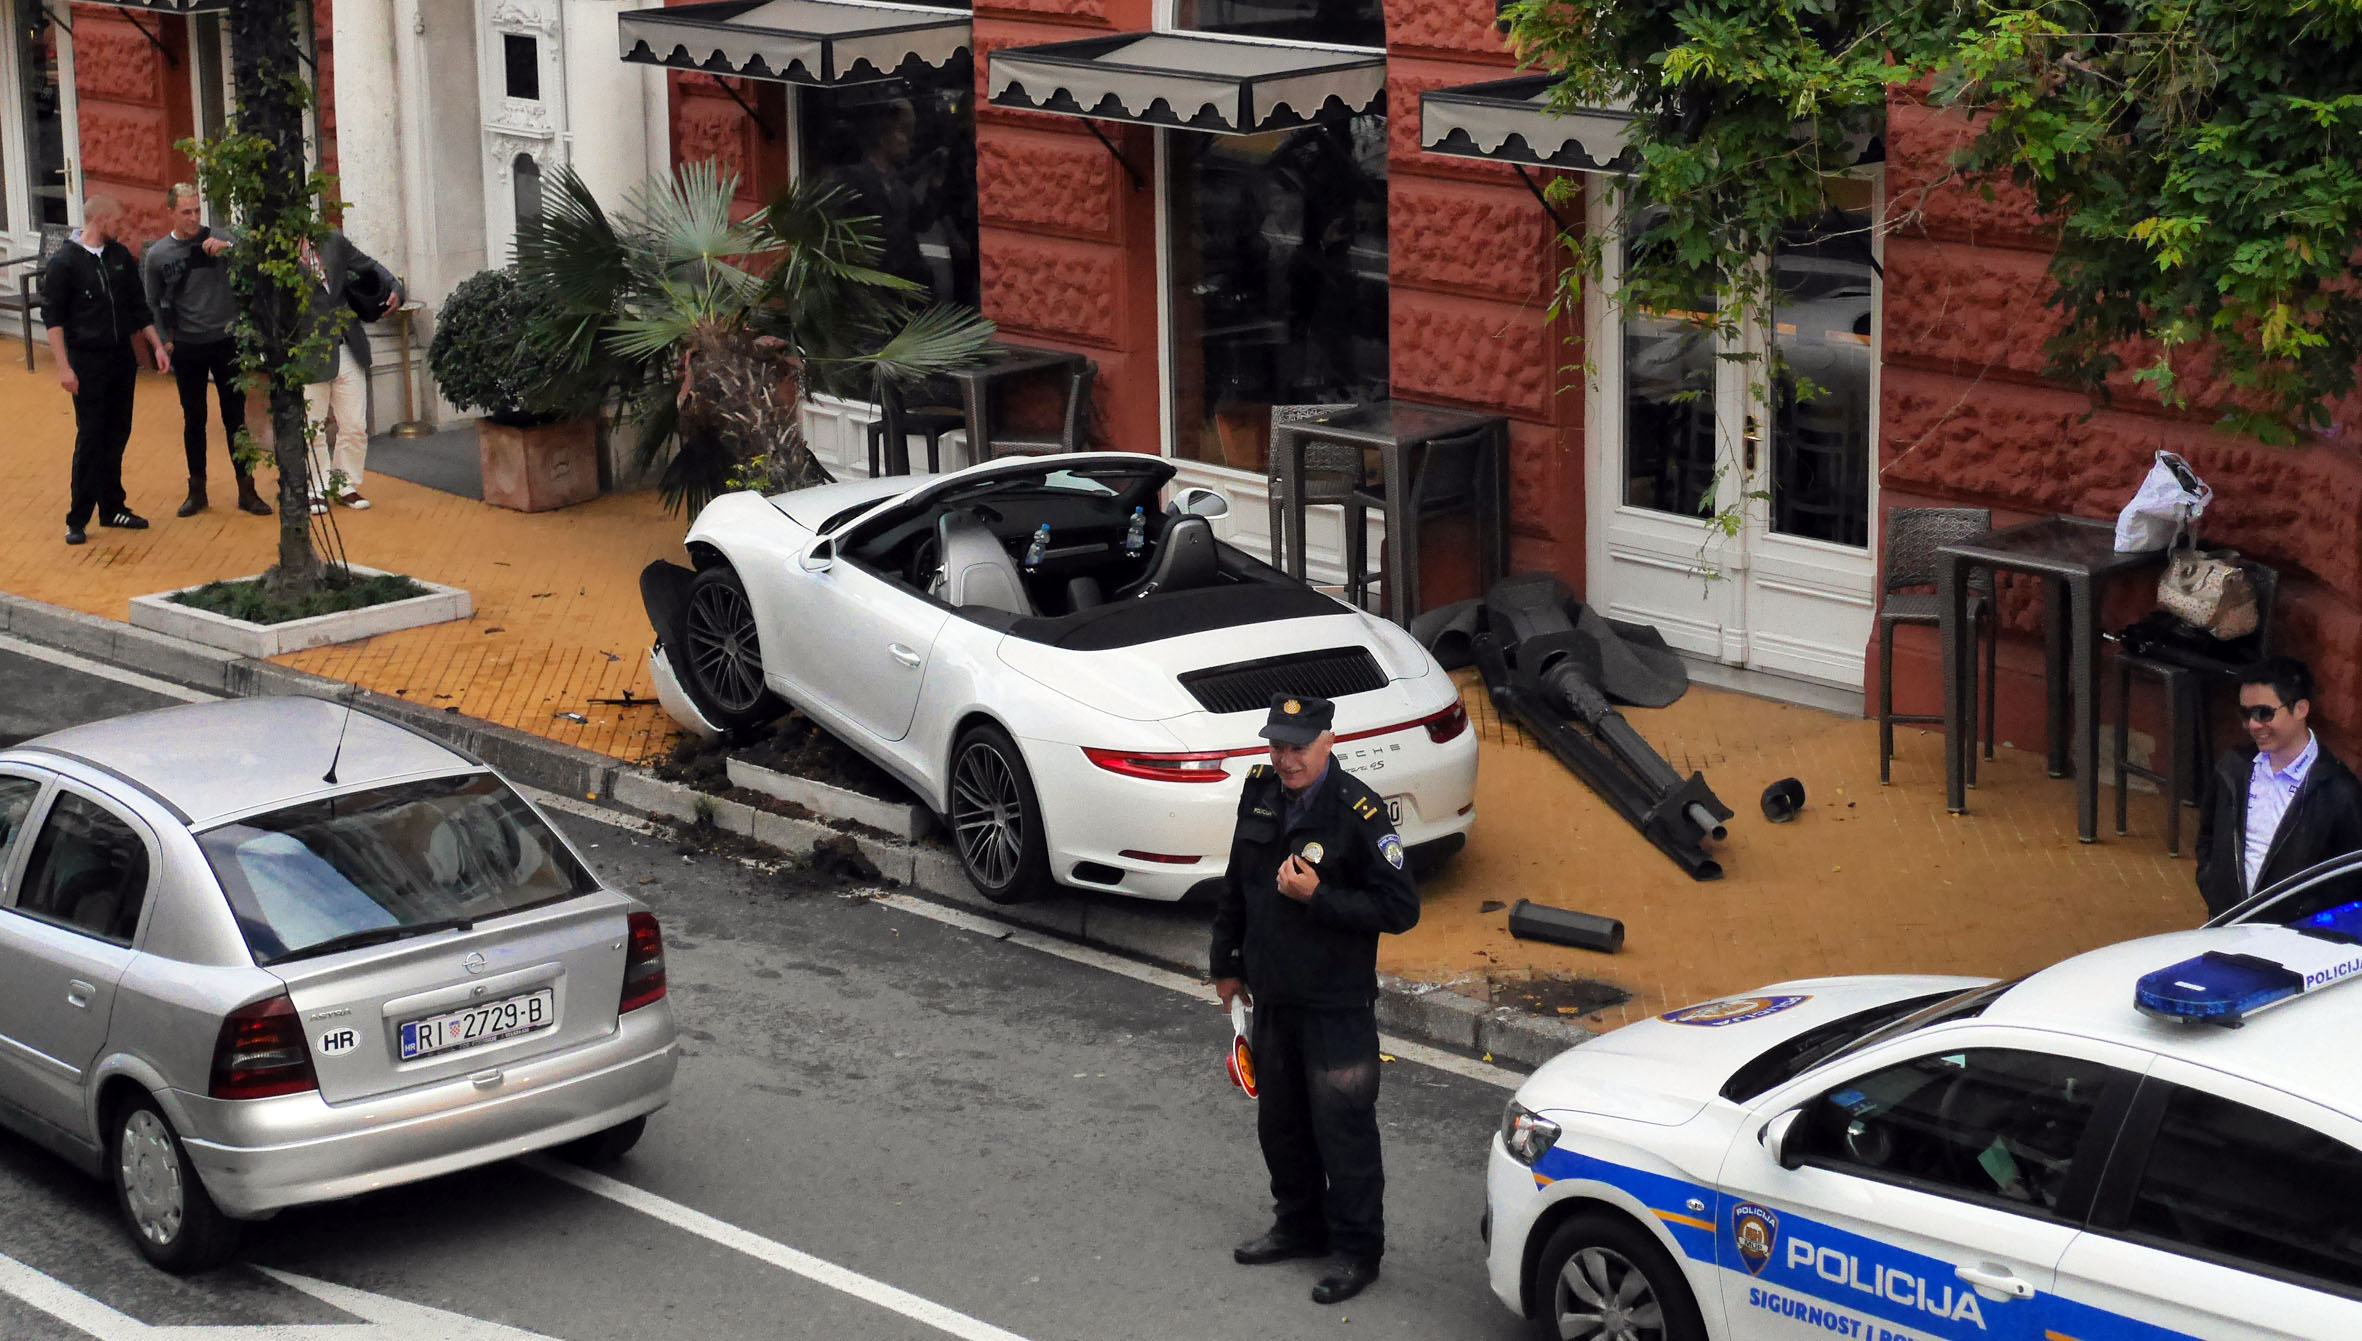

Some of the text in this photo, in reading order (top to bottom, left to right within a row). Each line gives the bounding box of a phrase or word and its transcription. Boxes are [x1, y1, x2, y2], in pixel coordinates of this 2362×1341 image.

[1336, 743, 1401, 761] SCHE
[419, 1021, 443, 1050] RI
[463, 998, 542, 1039] 2729-B
[323, 1030, 354, 1052] HR
[405, 1042, 416, 1052] HR
[1736, 1206, 1776, 1228] POLICIJA
[1744, 1239, 1763, 1251] MUP
[1787, 1236, 1987, 1330] POLICIJA
[1750, 1287, 1862, 1338] SIGURNOST
